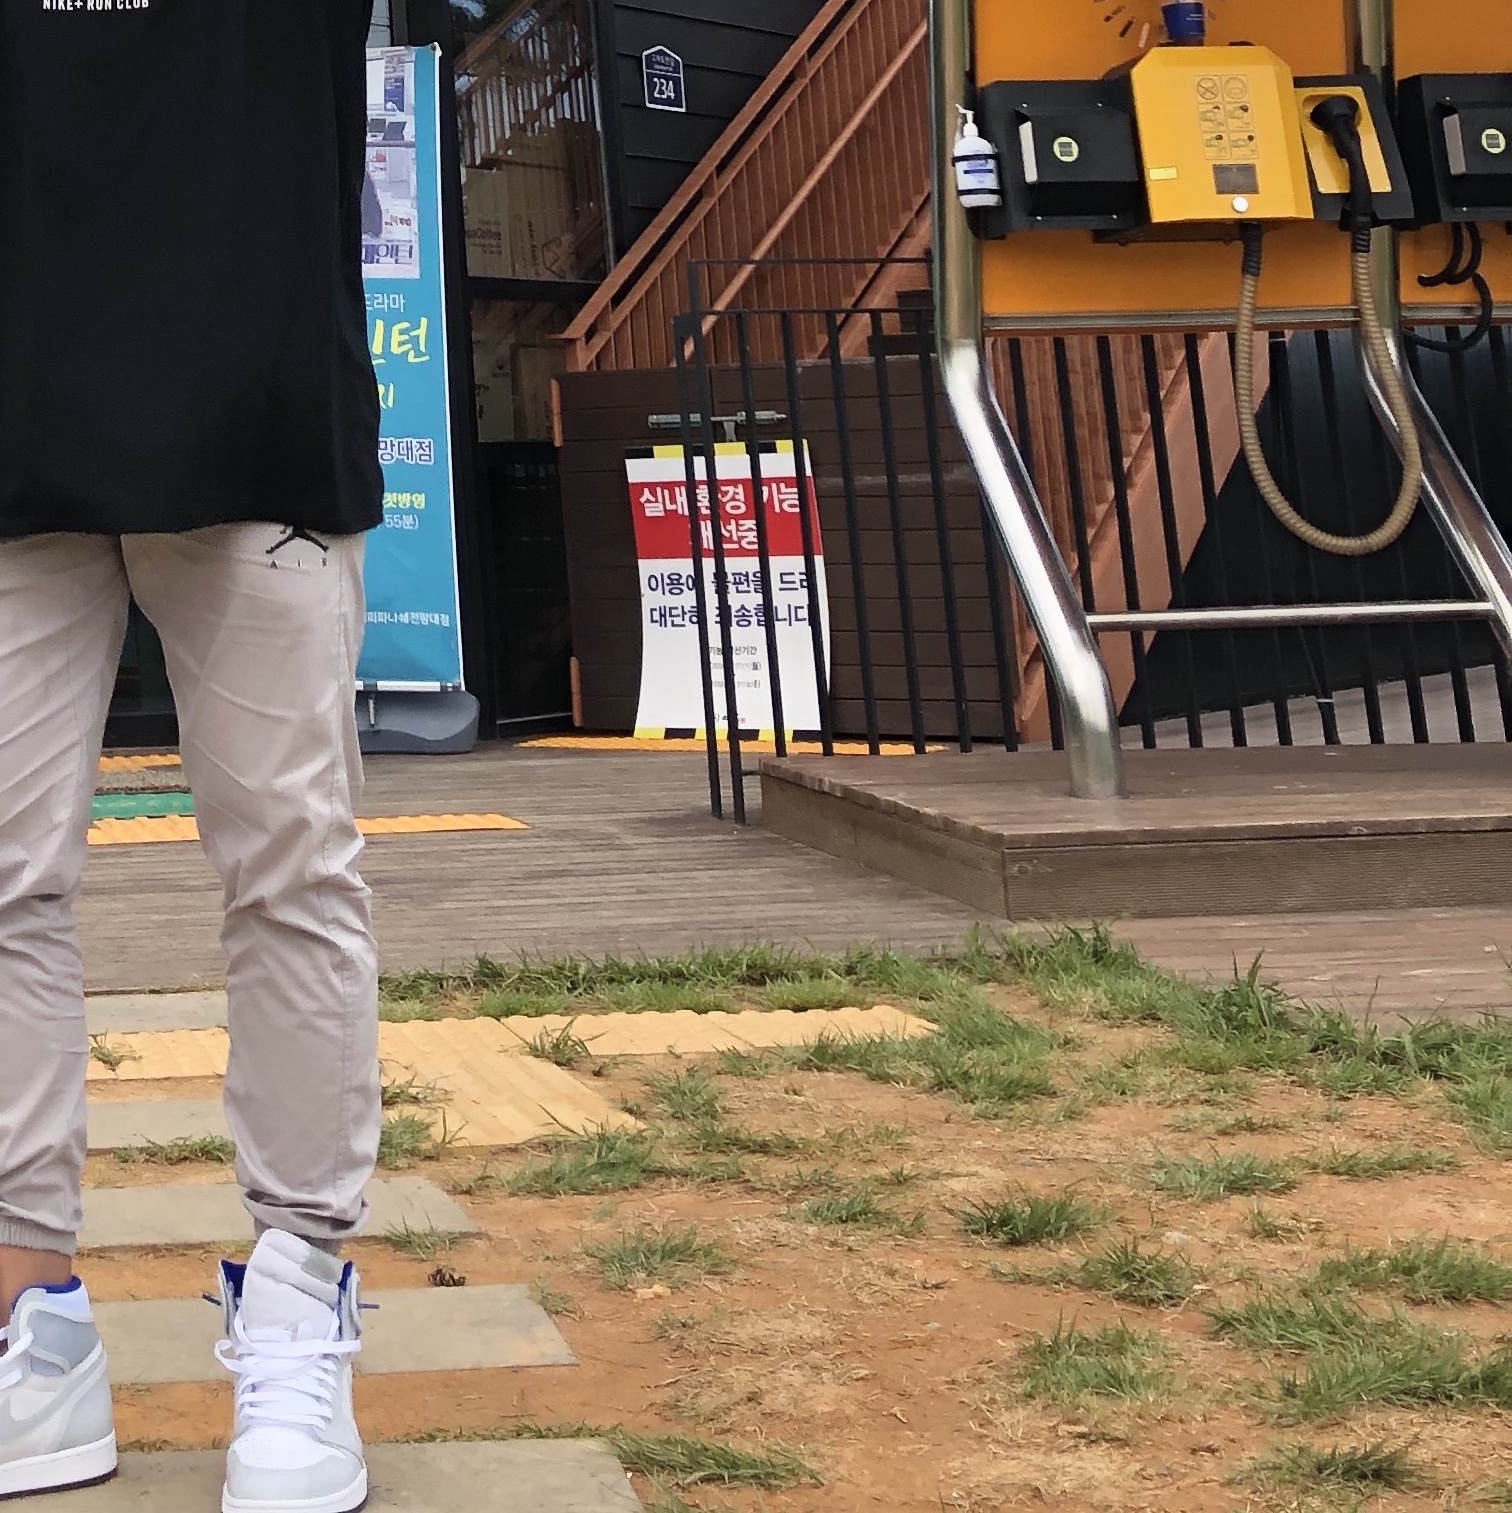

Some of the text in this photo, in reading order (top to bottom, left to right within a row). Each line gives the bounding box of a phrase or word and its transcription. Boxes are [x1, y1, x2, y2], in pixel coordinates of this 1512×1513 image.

[653, 78, 675, 99] 234
[270, 557, 327, 570] AIR
[364, 611, 450, 626] 피파나쉐전망대점
